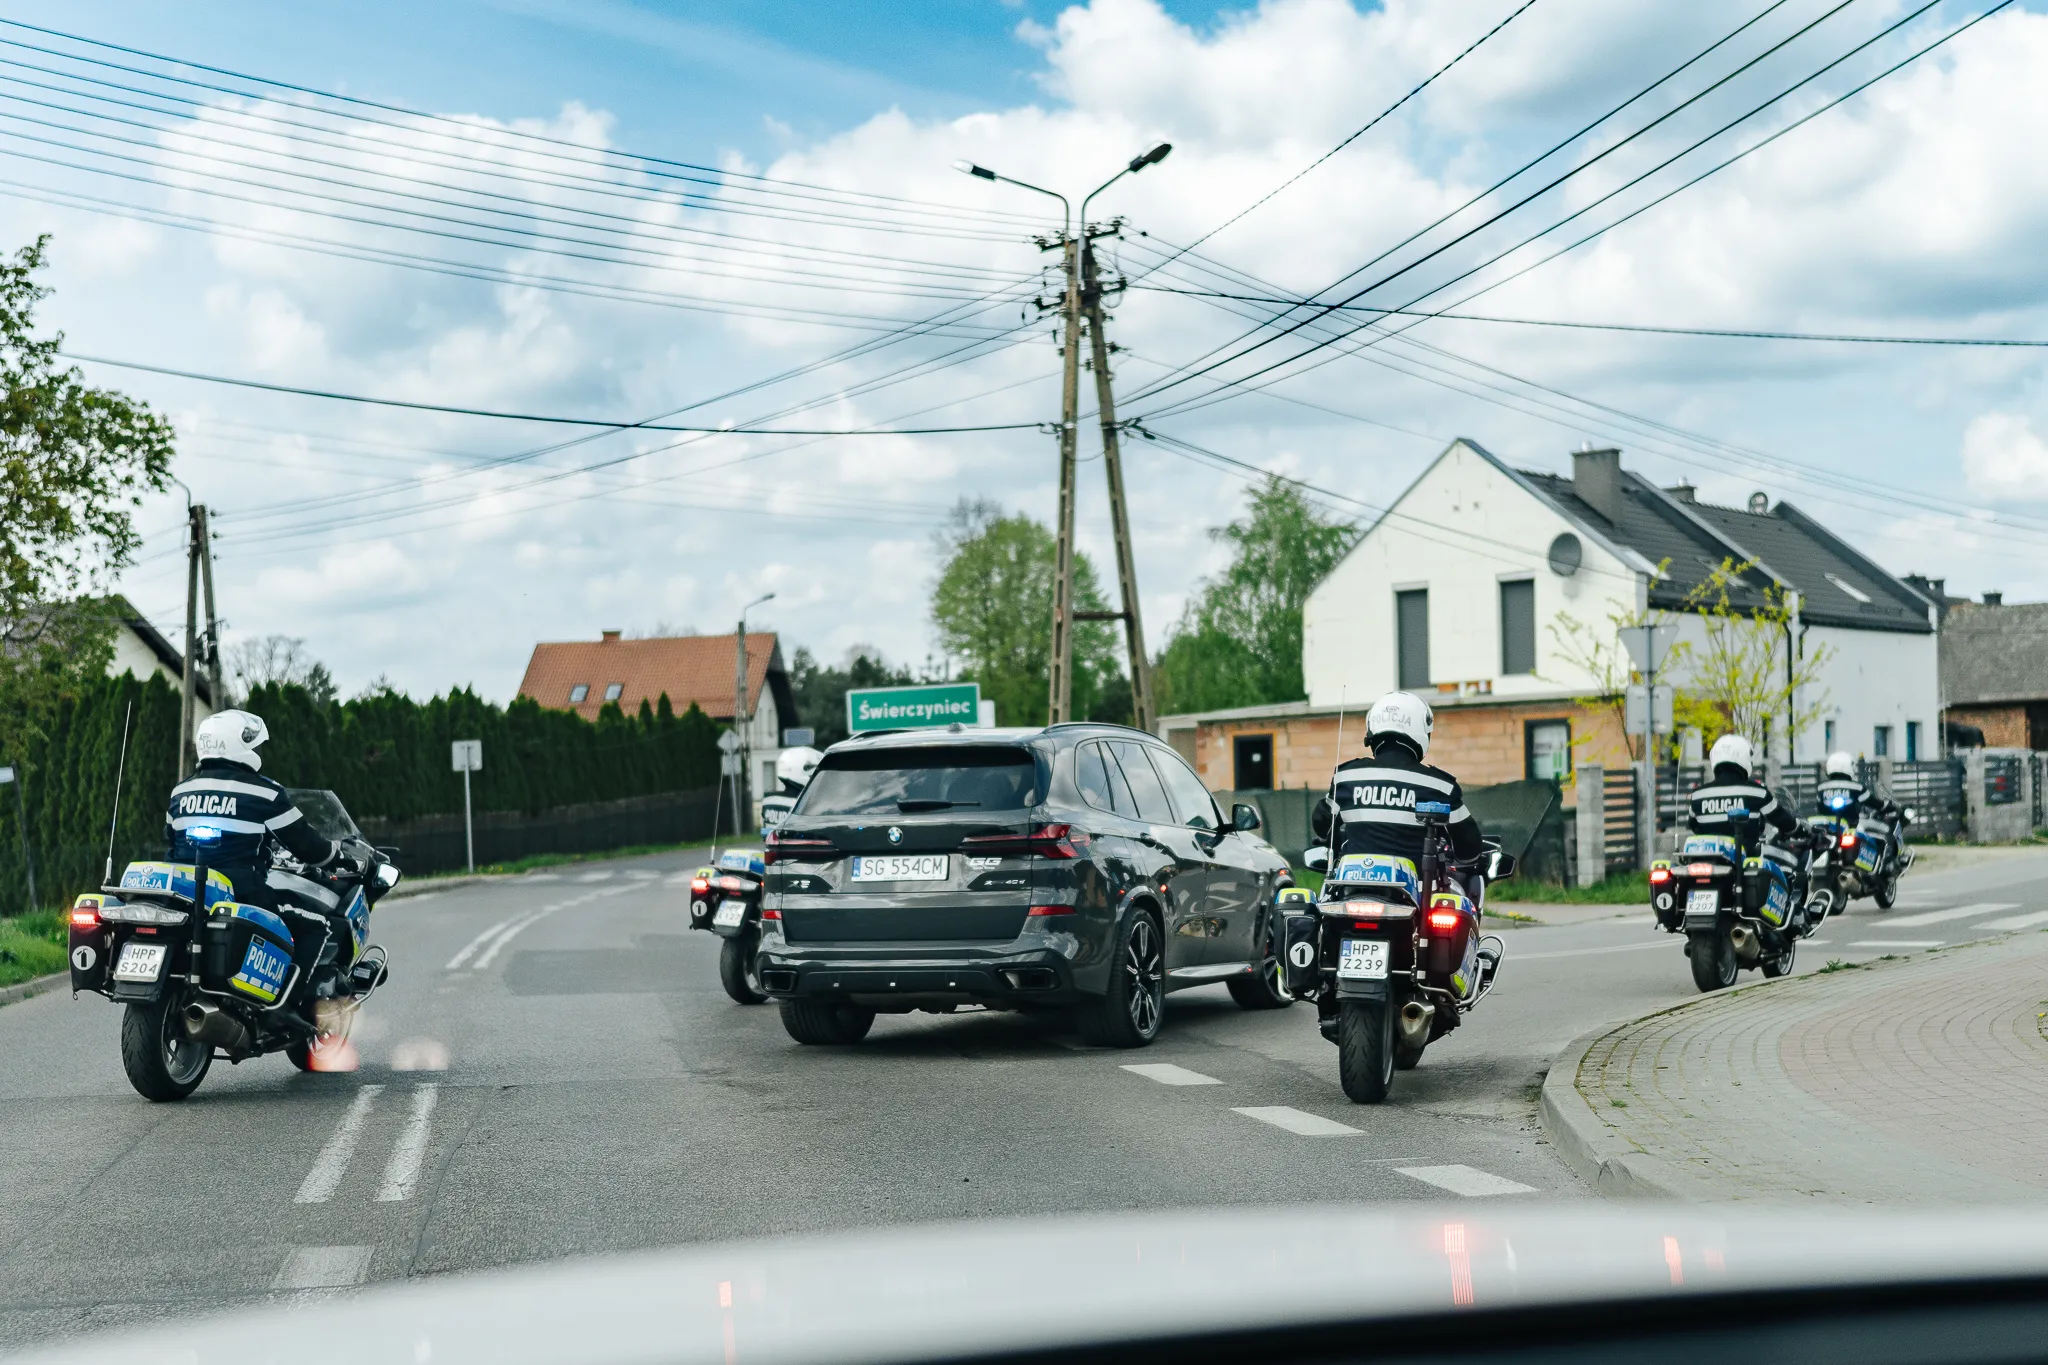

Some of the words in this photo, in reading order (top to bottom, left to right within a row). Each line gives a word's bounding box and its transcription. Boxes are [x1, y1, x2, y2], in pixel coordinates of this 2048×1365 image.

[859, 698, 970, 720] Świerczyniec
[1353, 785, 1416, 808] POLICJA
[179, 794, 237, 816] POLICJA
[1701, 797, 1745, 814] POLICJA
[864, 859, 885, 876] SG
[892, 858, 943, 875] 554CM
[1347, 870, 1388, 881] POLICJA
[126, 876, 163, 889] POLICJA
[1694, 893, 1712, 901] HPP
[1688, 902, 1714, 911] K207
[131, 948, 156, 960] HPP
[1352, 943, 1379, 956] HPP
[120, 962, 157, 974] S204
[246, 945, 285, 984] POLICJA
[1343, 958, 1383, 971] Z239
